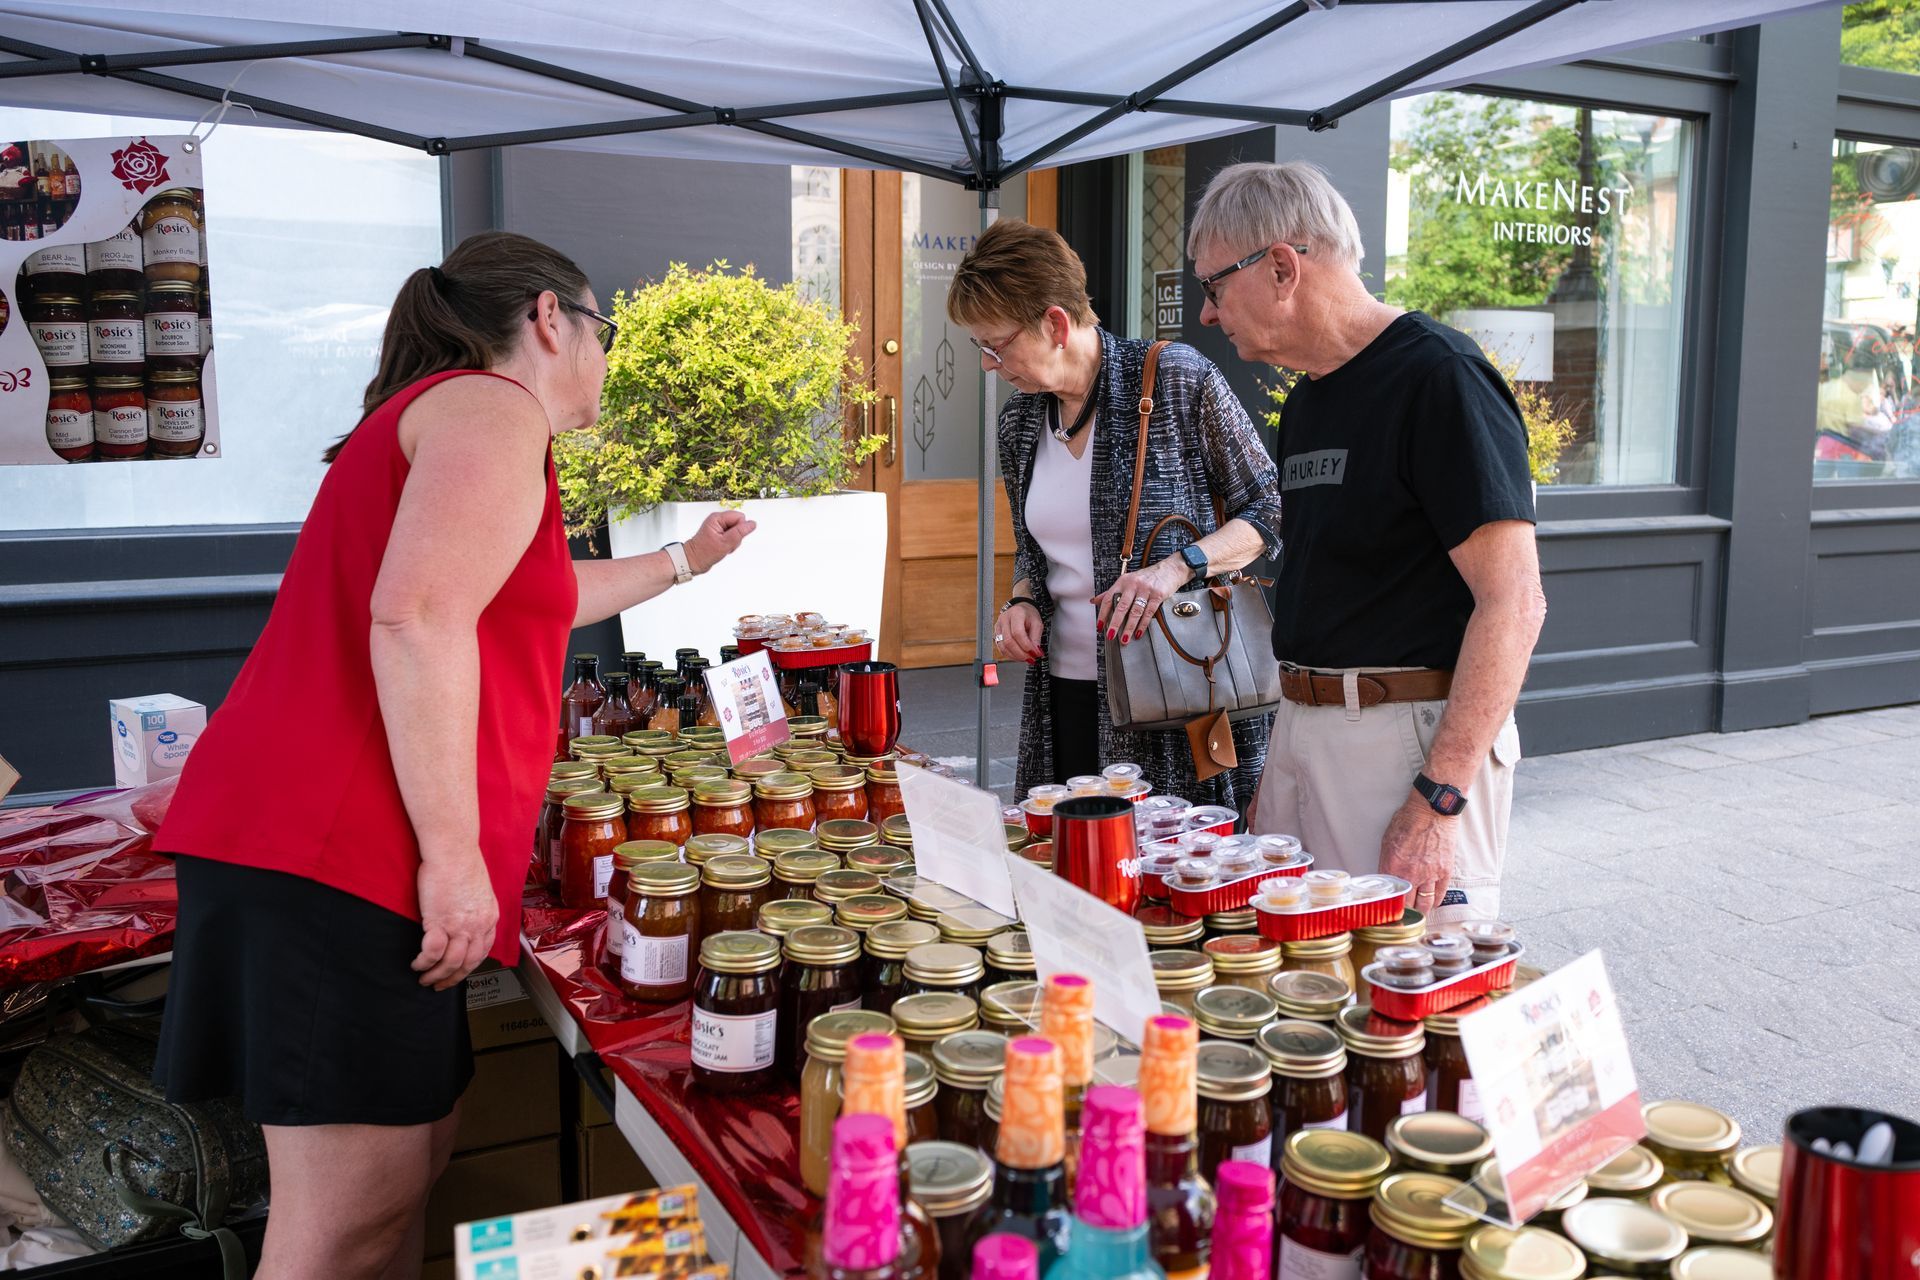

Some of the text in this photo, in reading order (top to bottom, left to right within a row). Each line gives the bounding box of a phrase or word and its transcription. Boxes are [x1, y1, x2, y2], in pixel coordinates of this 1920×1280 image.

[155, 222, 191, 236] Rosie's
[1493, 221, 1593, 247] INTERIORS
[41, 254, 63, 262] BEAR
[100, 252, 134, 260] FROG Jam
[153, 248, 178, 256] Monkey
[912, 261, 958, 271] DESIGN BY
[1158, 307, 1183, 325] OUT
[152, 318, 192, 332] Rosie's
[36, 328, 76, 343] Rosie's
[94, 325, 133, 340] Rosie's
[111, 410, 142, 422] Rosie's
[157, 406, 195, 420] Rosie's
[1290, 457, 1341, 481] HURLEY
[146, 714, 165, 726] 100
[167, 743, 190, 751] White
[163, 750, 189, 759] Spoon
[693, 1015, 725, 1038] osie's
